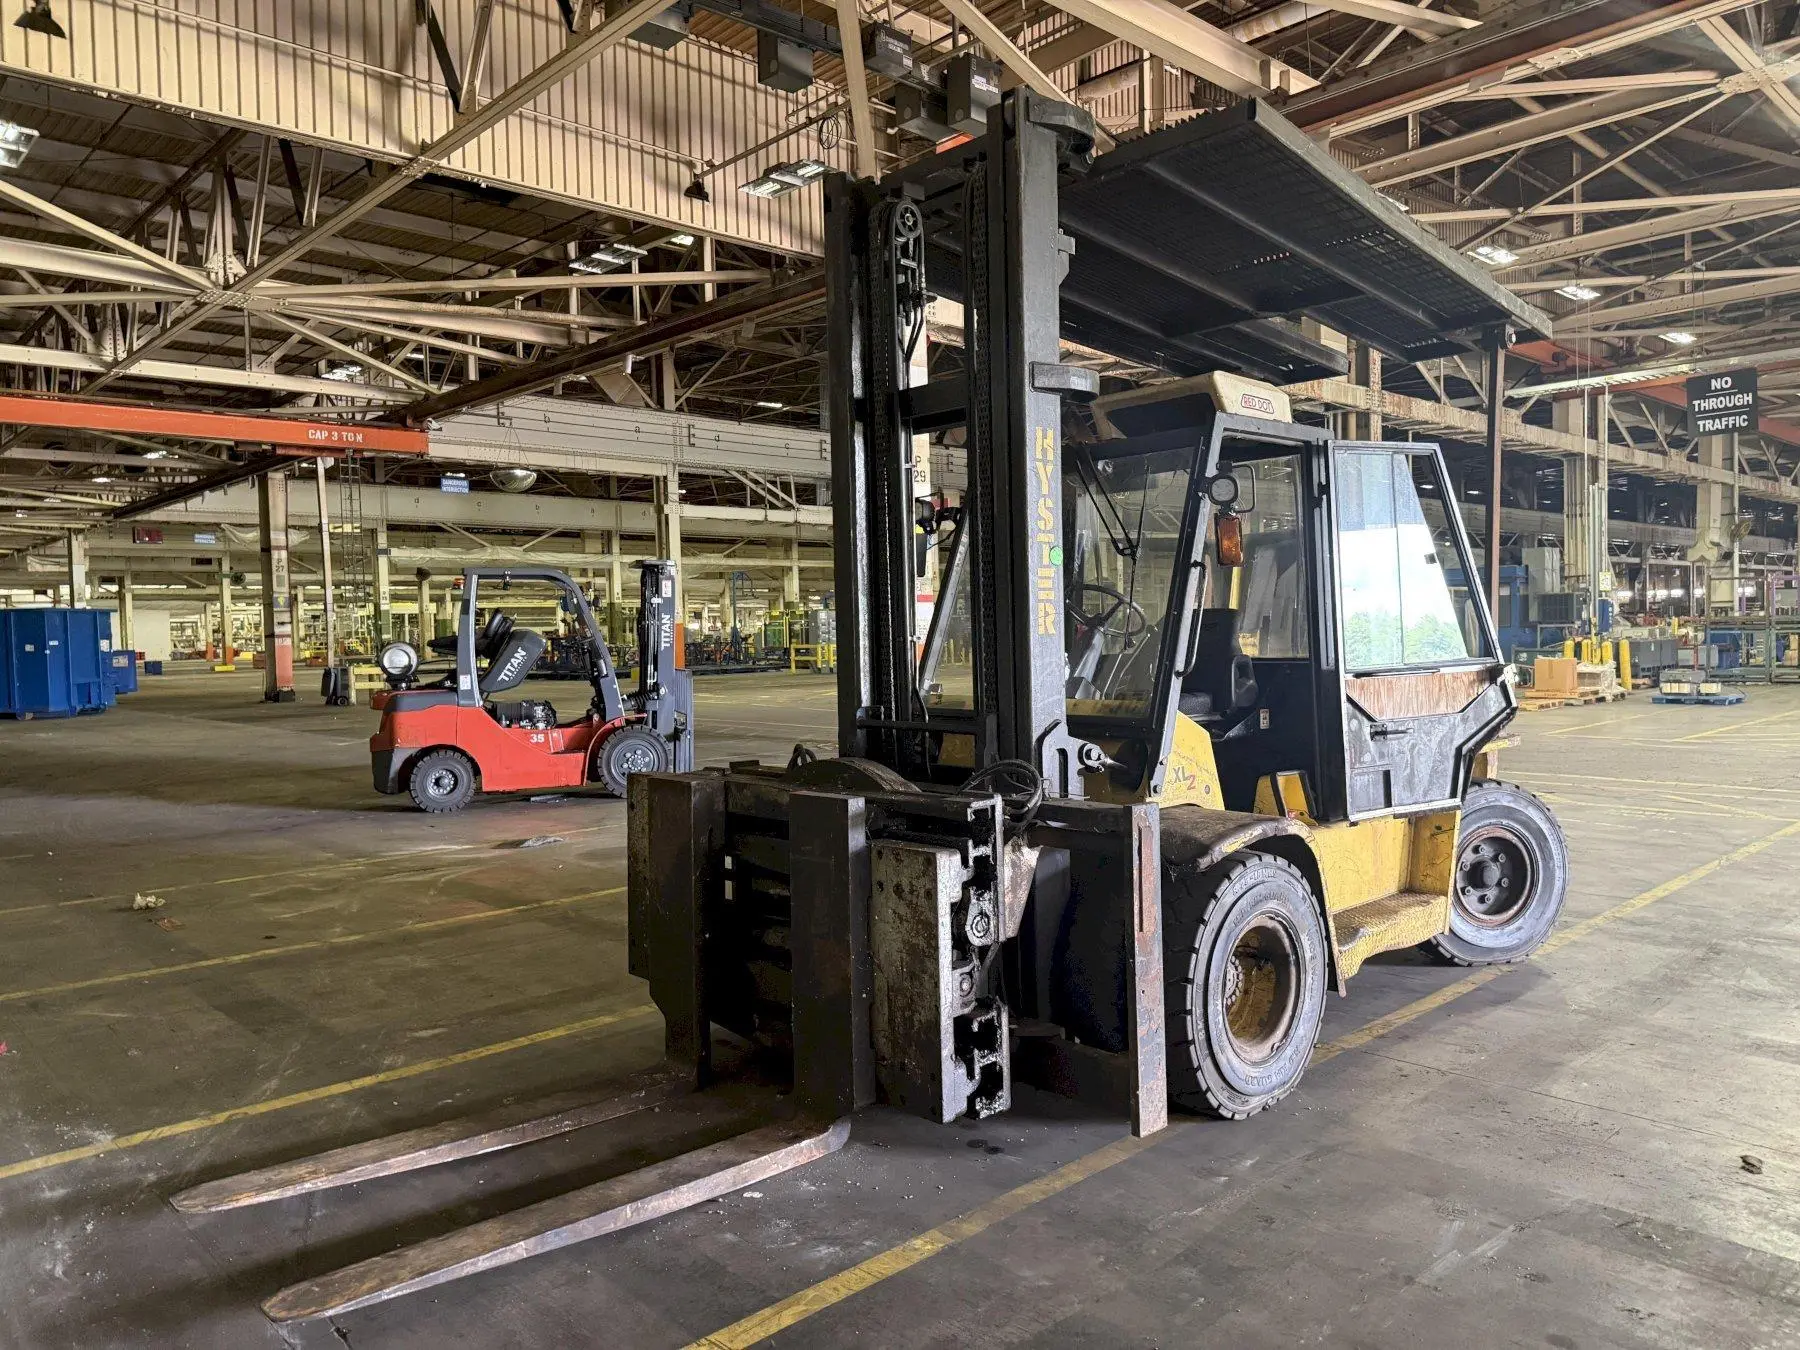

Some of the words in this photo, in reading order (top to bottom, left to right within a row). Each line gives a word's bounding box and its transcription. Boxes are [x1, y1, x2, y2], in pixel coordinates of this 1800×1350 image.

[1711, 377, 1732, 390] NO
[1243, 396, 1257, 408] RED
[1257, 399, 1271, 412] DOT
[1692, 392, 1753, 412] THROUGH
[1697, 414, 1749, 433] TRAFFIC
[308, 429, 329, 441] CAP
[331, 431, 339, 442] 3
[341, 431, 363, 443] TON
[914, 455, 922, 468] P
[913, 471, 926, 483] 29
[1035, 426, 1056, 636] HYSTER
[660, 612, 671, 651] TITAN
[496, 646, 527, 682] TITAN
[530, 733, 546, 744] 35
[1172, 765, 1189, 784] XL
[1186, 774, 1197, 791] 2
